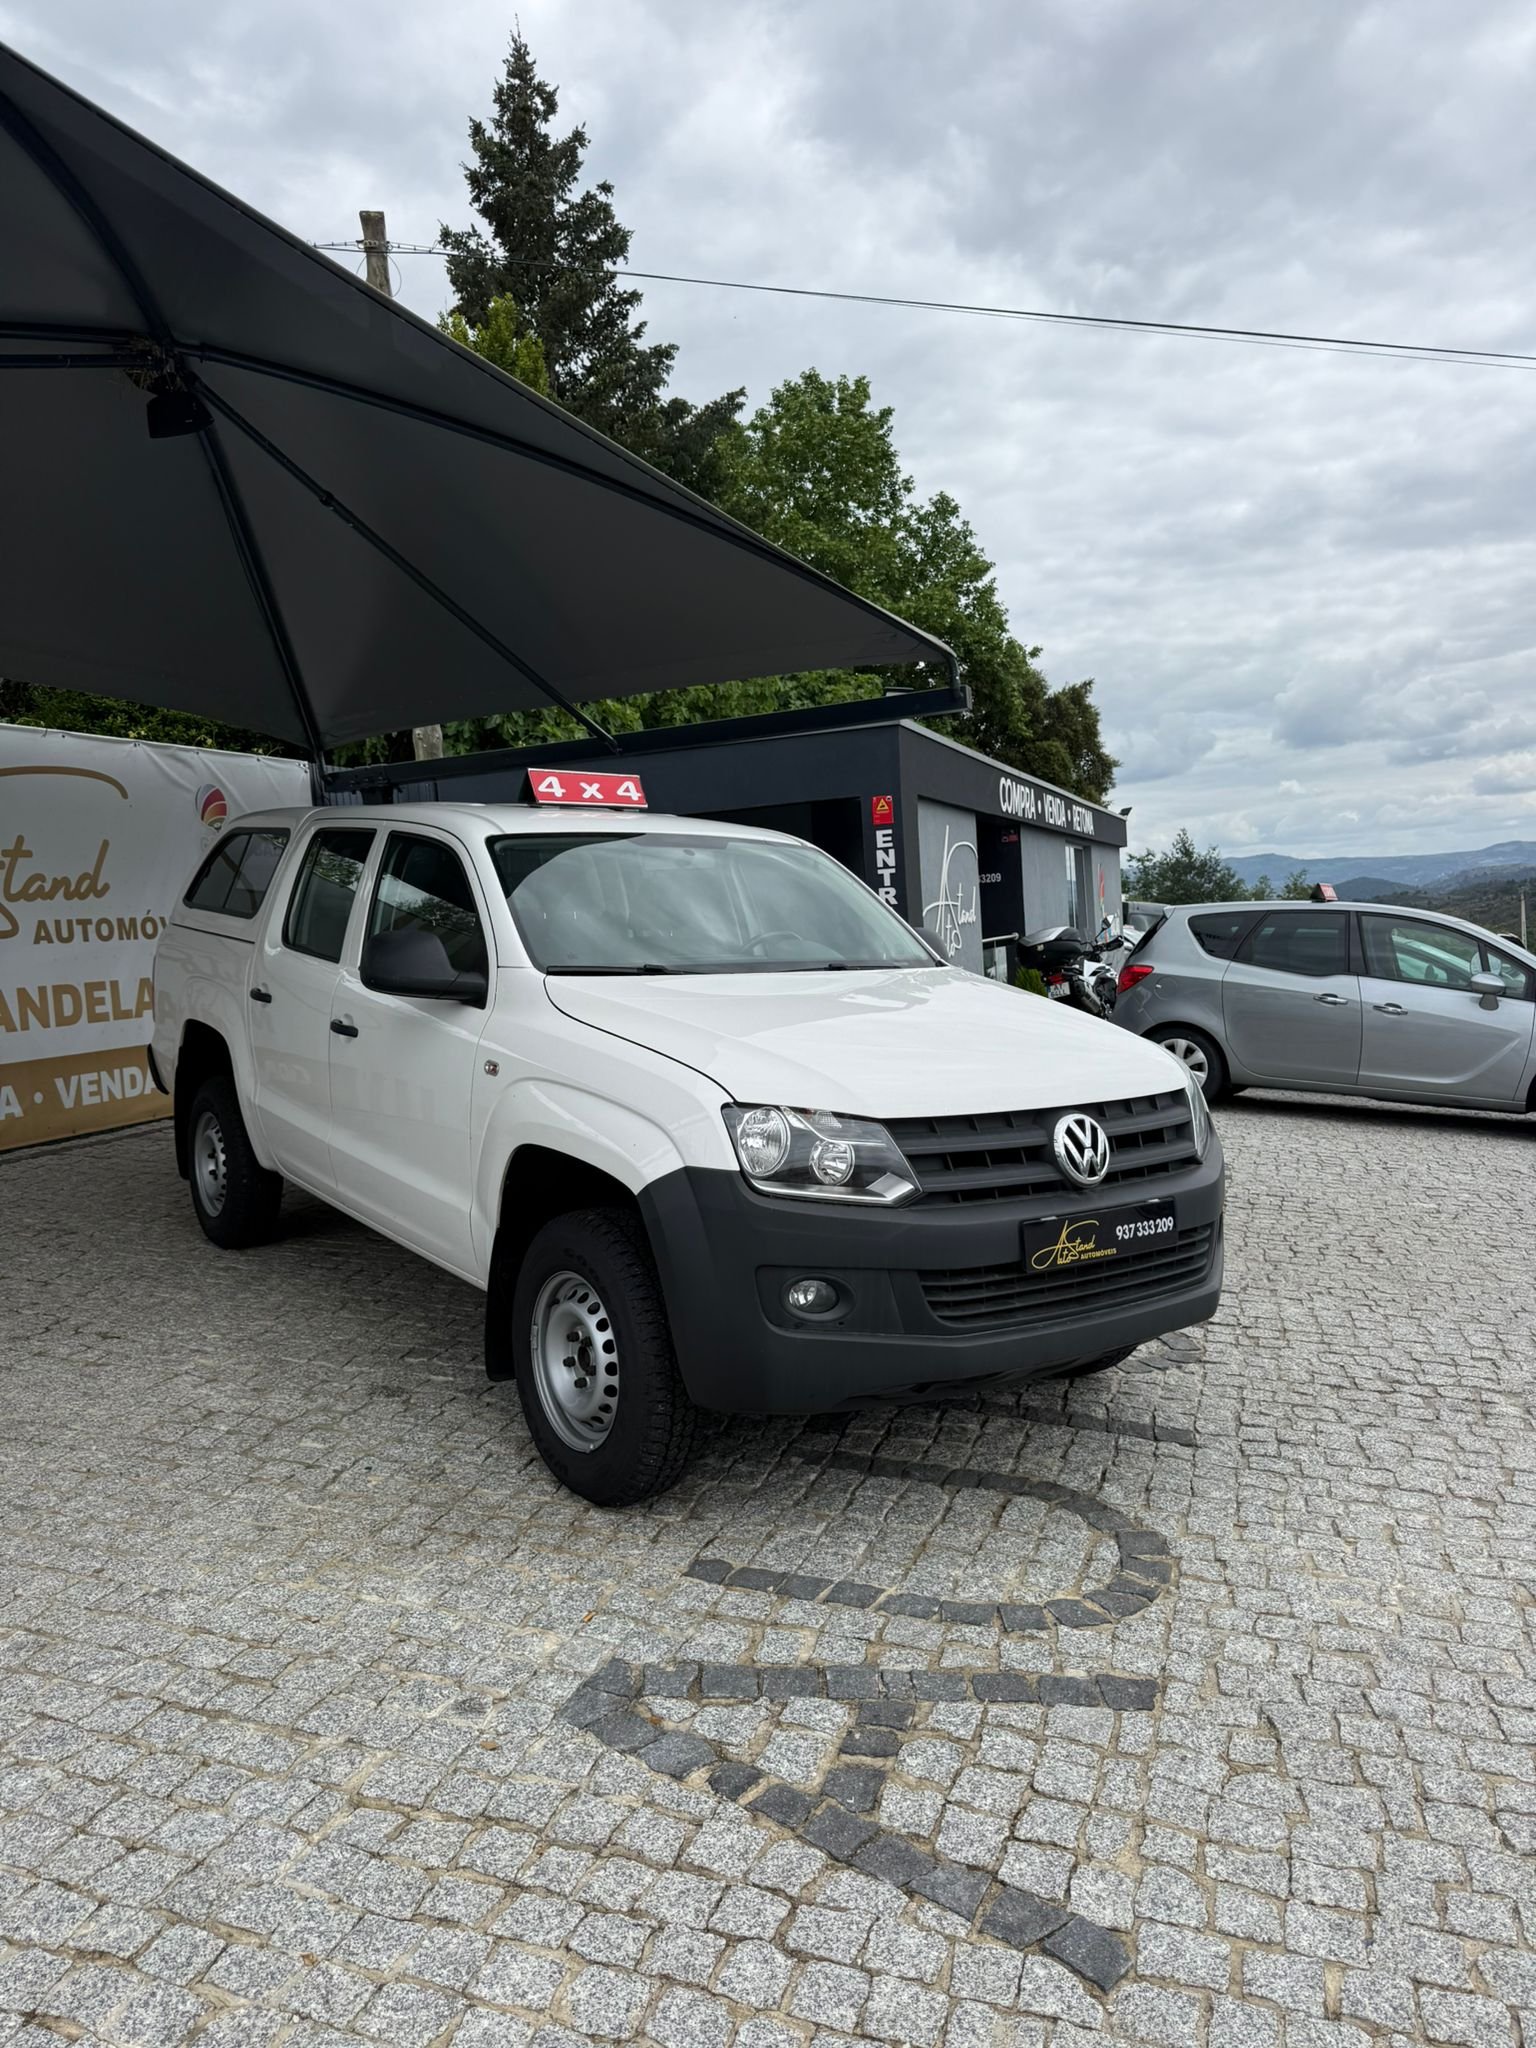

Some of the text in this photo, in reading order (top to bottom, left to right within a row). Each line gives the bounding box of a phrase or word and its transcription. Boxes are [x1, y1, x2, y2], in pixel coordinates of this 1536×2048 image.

[999, 776, 1094, 835] COMPRA VENDA RETOMA
[1115, 1216, 1174, 1241] 937 333 209
[1080, 1247, 1117, 1260] AUTOMÓVEIS
